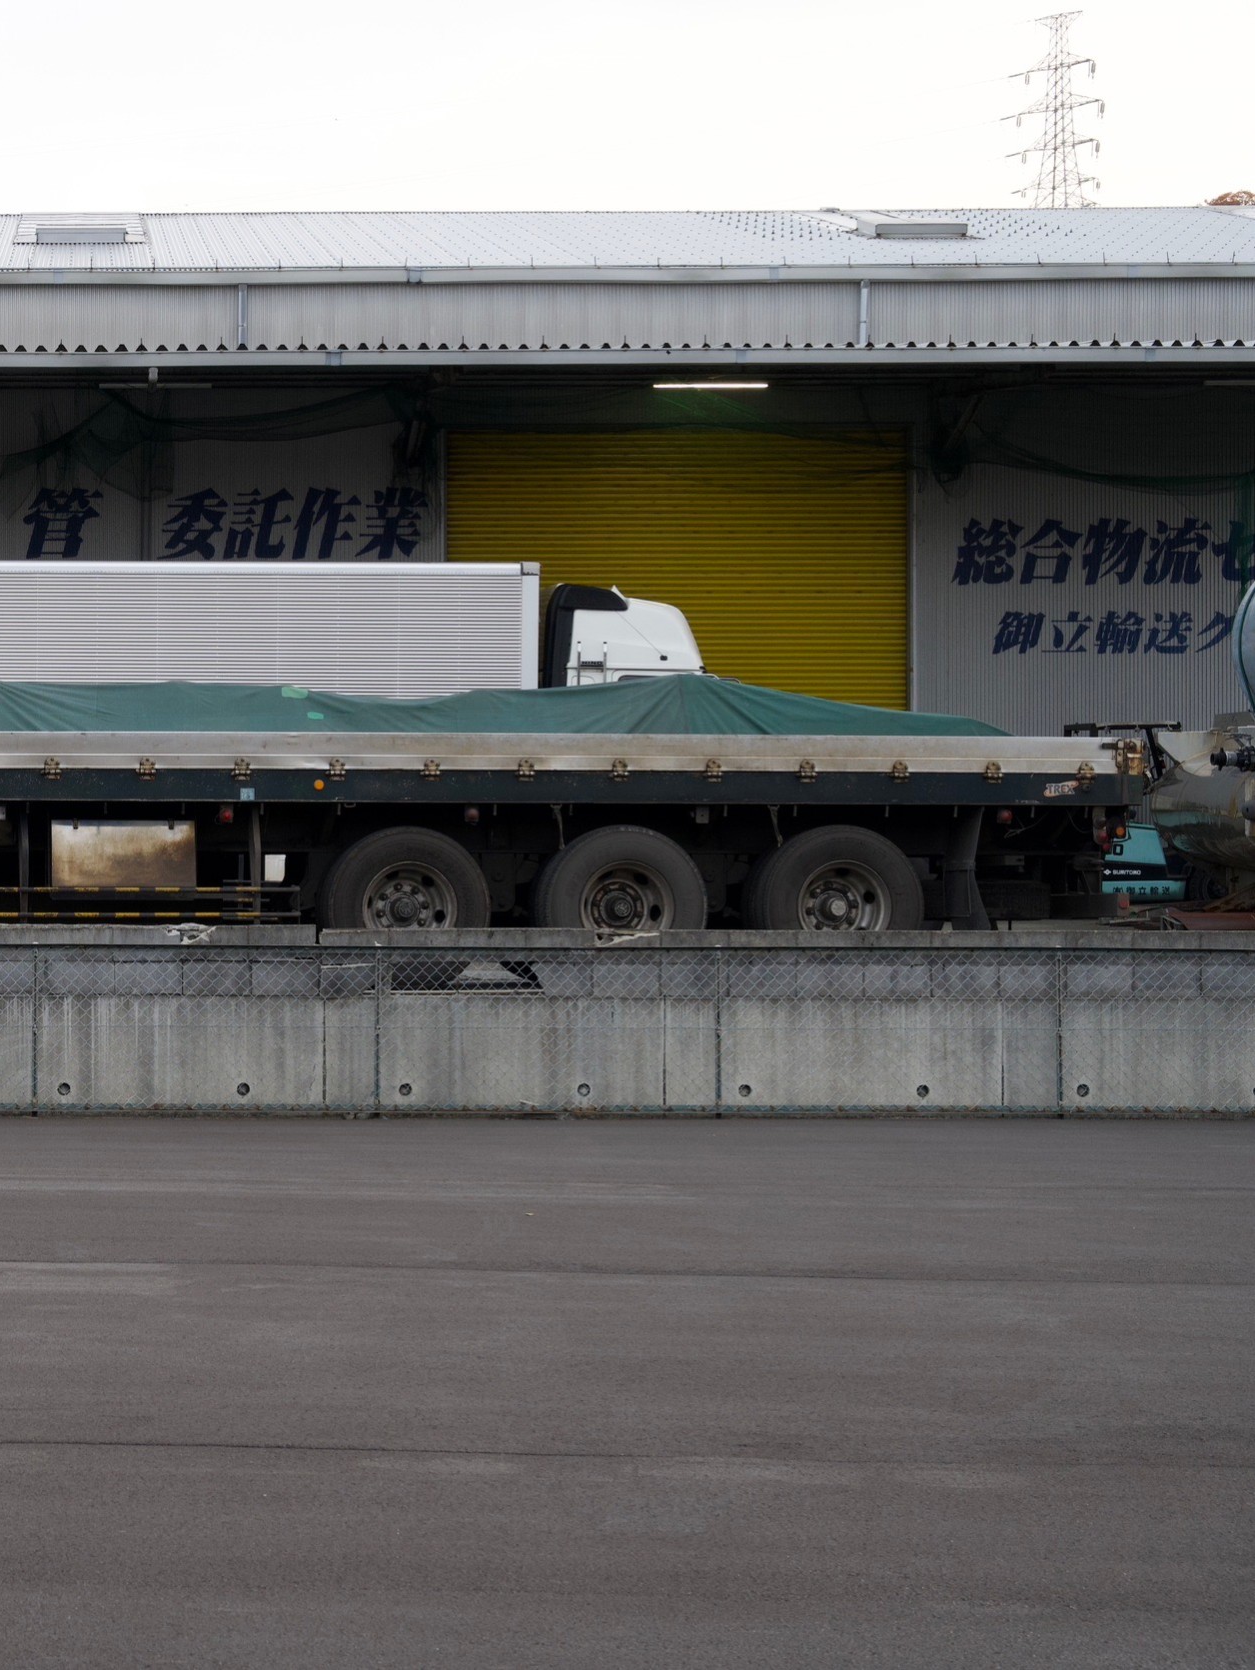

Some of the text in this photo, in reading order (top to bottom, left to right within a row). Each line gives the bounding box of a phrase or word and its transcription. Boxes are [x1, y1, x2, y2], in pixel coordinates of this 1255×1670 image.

[157, 486, 428, 560] 委託作業
[1046, 783, 1075, 795] TREX
